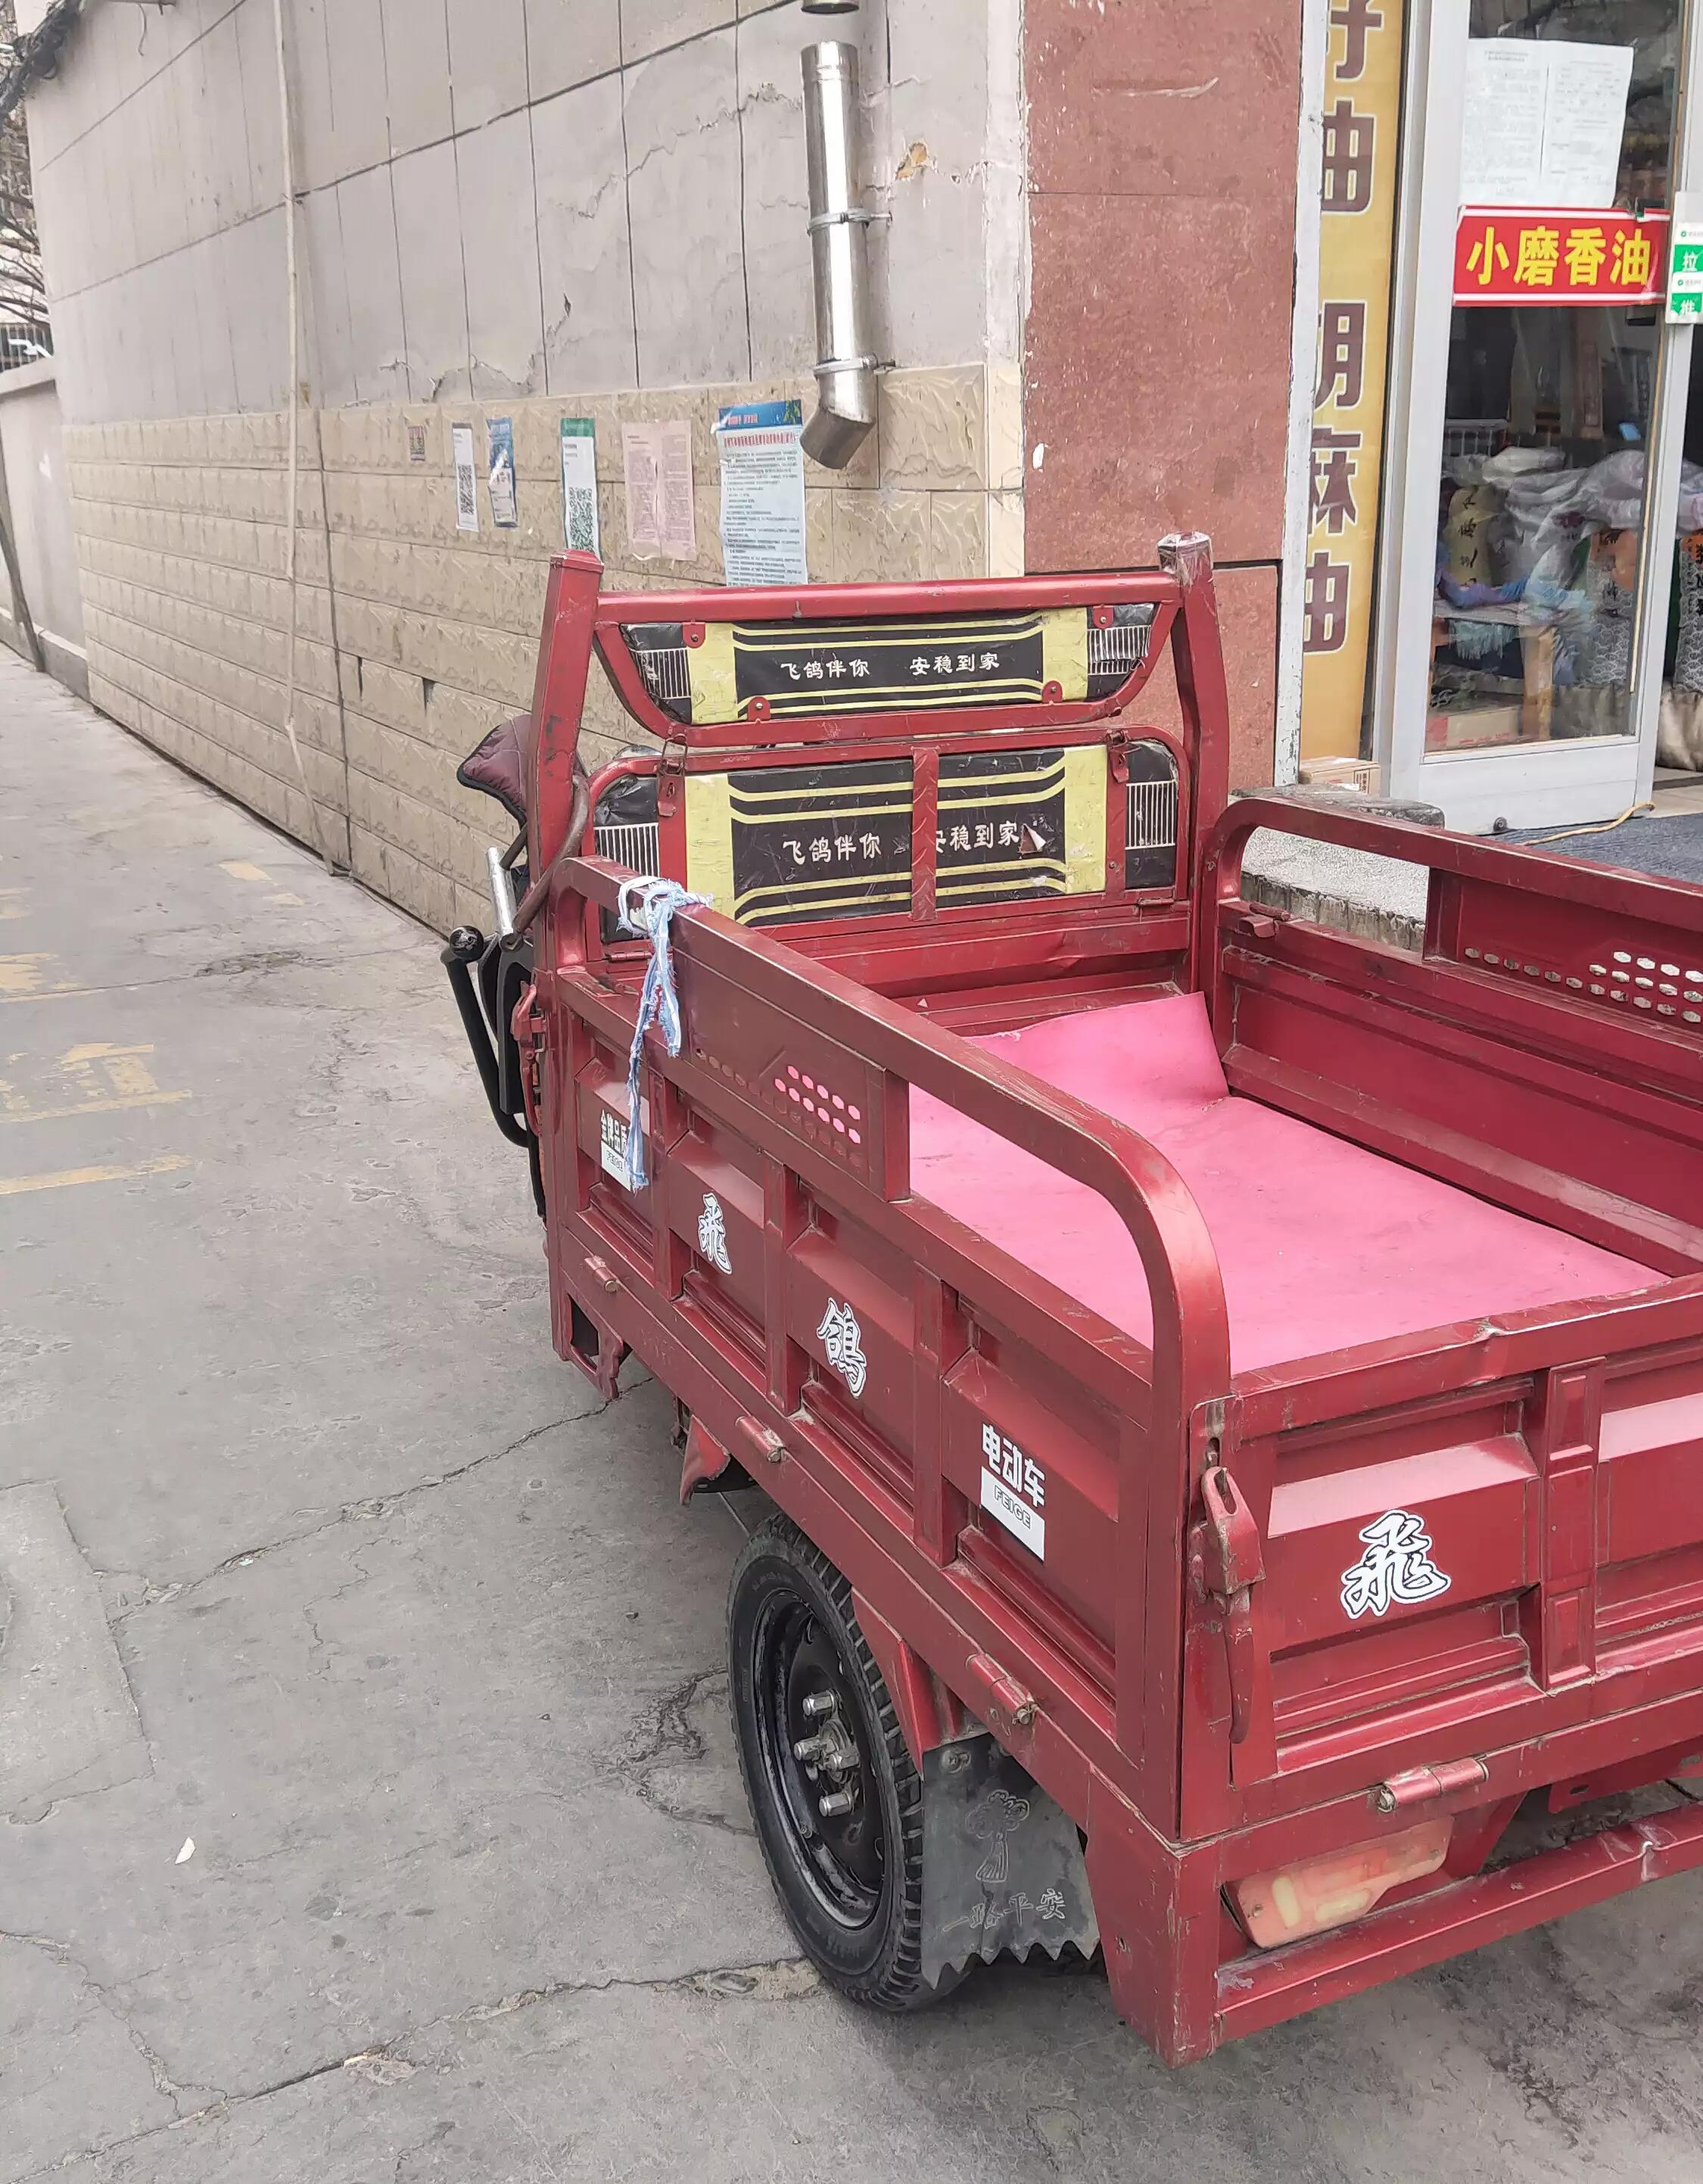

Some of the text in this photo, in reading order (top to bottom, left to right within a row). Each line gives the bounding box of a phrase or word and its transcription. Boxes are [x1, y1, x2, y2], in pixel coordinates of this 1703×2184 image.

[1466, 226, 1650, 285] 小磨香油
[1682, 249, 1698, 272] 拉
[780, 652, 1000, 680] 飞鸽伴你 安稳到家
[783, 833, 881, 864] 飞鸽伴你
[982, 1423, 1045, 1507] 电动车
[994, 1485, 1032, 1530] FEIGE
[942, 1888, 1066, 1932] 一路平安
